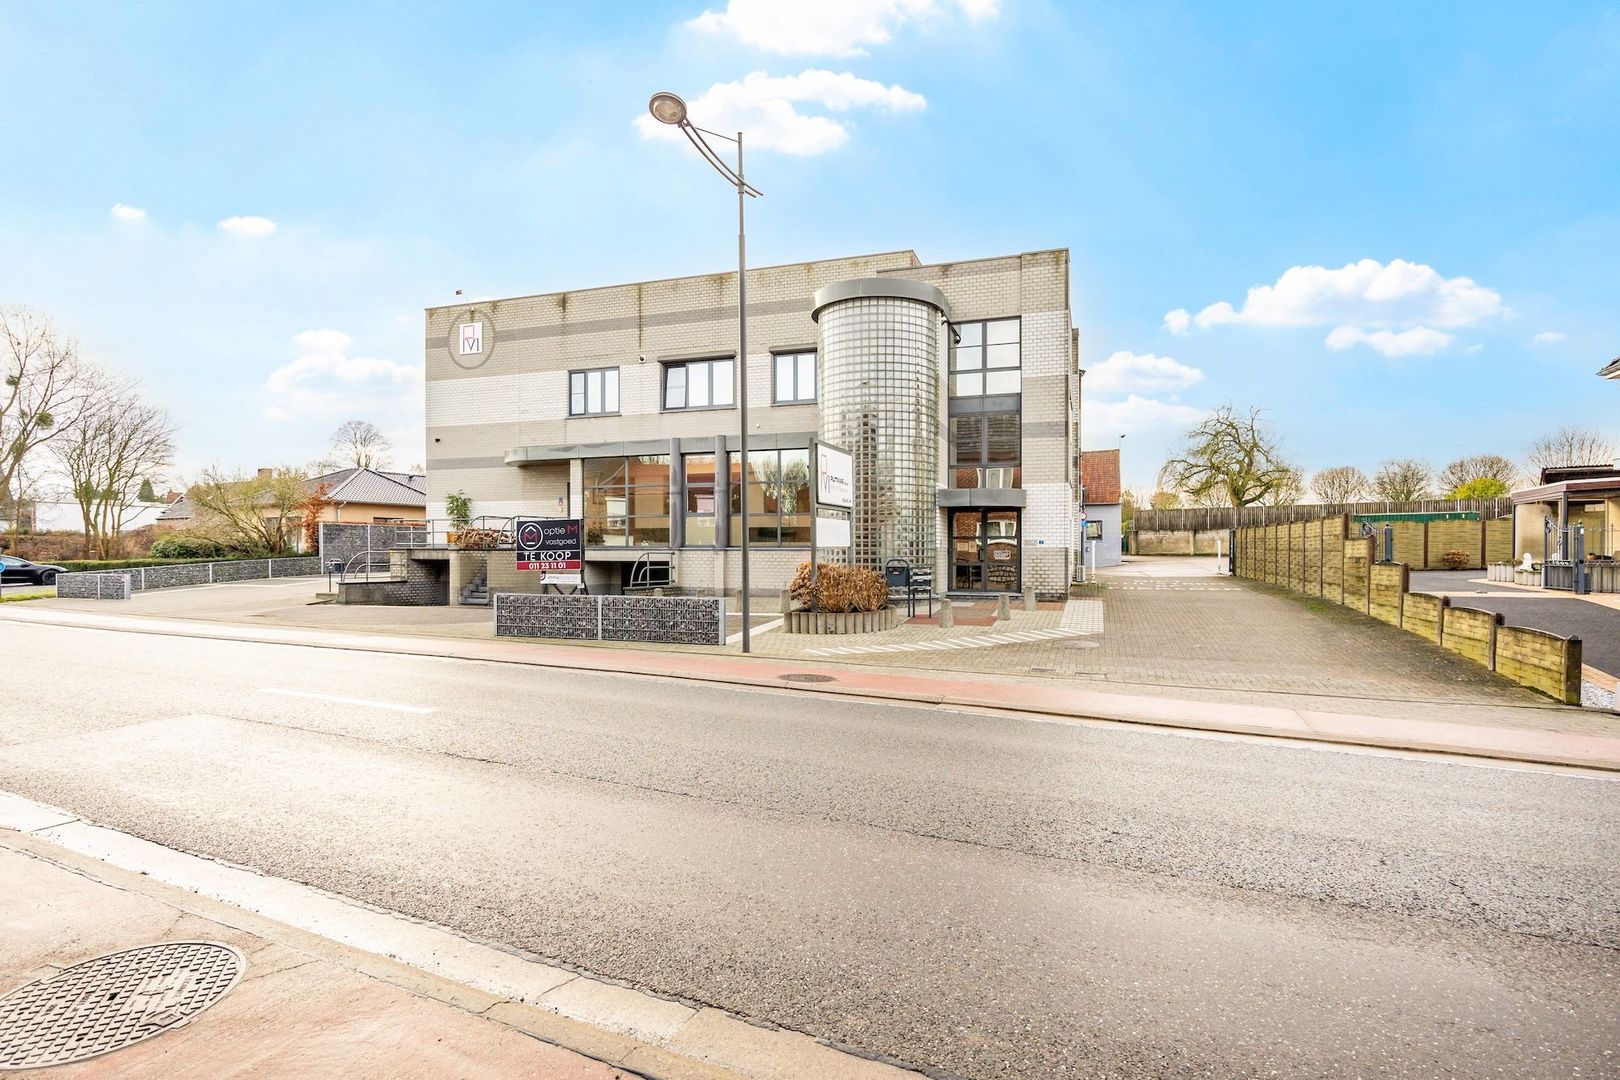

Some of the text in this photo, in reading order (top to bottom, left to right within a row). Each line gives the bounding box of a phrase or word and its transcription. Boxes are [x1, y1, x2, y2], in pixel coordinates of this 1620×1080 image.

[544, 524, 578, 536] optie M
[524, 551, 571, 561] TE KOOP
